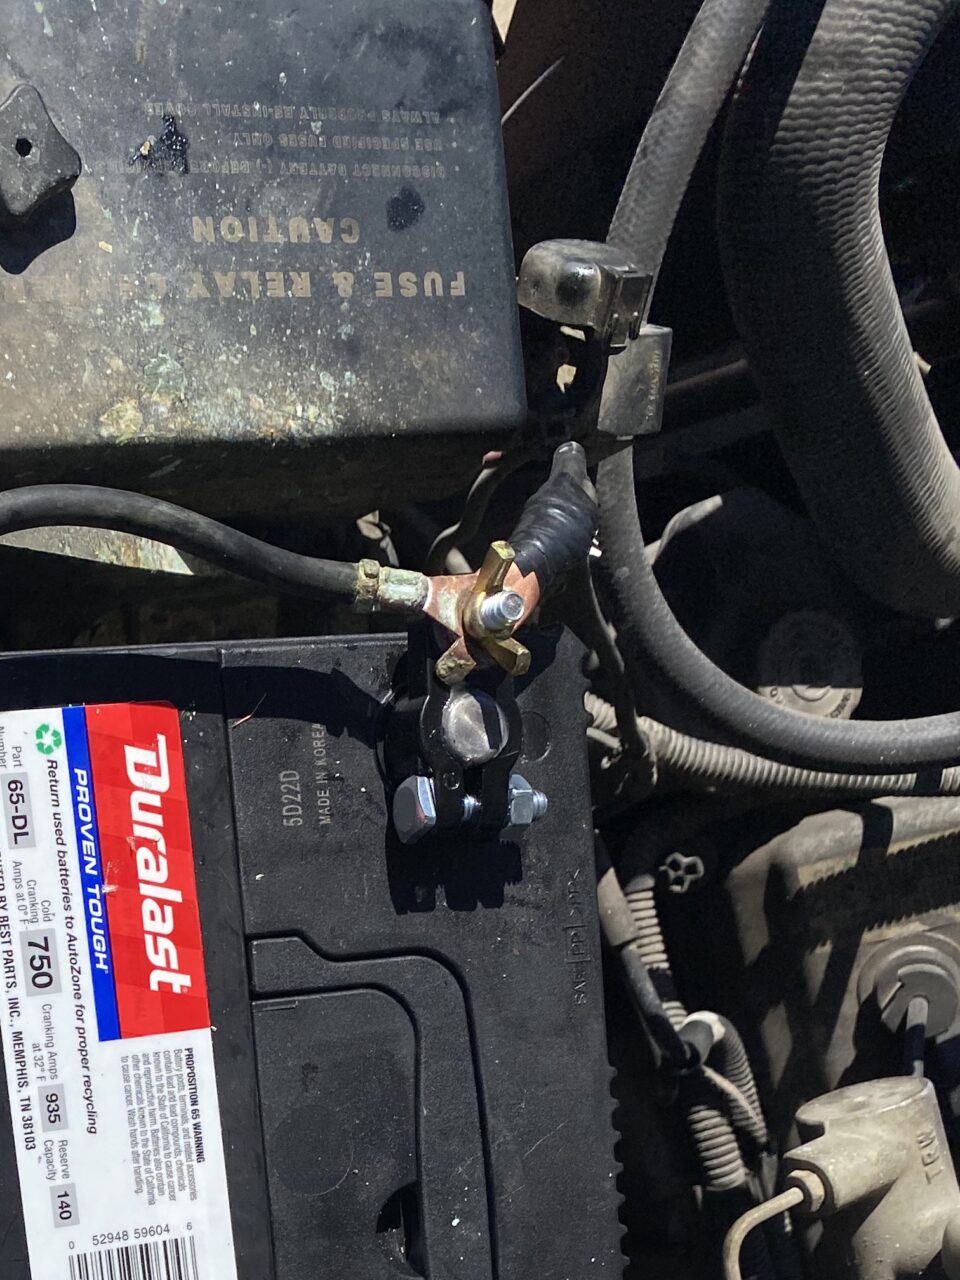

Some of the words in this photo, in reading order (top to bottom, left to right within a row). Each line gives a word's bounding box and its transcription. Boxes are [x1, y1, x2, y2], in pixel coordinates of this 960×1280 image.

[192, 215, 361, 243] CAUTION
[189, 270, 312, 299] RELAY
[333, 271, 355, 298] &
[374, 270, 466, 297] FUSE
[11, 745, 23, 767] Part
[310, 723, 327, 766] KOREA
[46, 759, 62, 807] Return
[315, 770, 328, 784] IN
[6, 779, 29, 844] 65-DL
[279, 769, 303, 827] 5D22D
[316, 790, 332, 825] MADE
[52, 812, 66, 846] used
[10, 860, 24, 889] Amps
[56, 849, 74, 911] batteries
[73, 767, 97, 876] PROVEN
[86, 884, 108, 970] TOUGH
[123, 733, 191, 997] Duralast
[16, 891, 25, 901] at
[25, 879, 40, 923] Cranking
[41, 899, 52, 922] Cold
[64, 915, 75, 929] to
[0, 949, 17, 993] PARTS,
[26, 936, 53, 989] 750
[66, 932, 84, 999] AutoZone
[6, 997, 21, 1027] INC.,
[39, 1003, 56, 1048] Cranking
[74, 1003, 86, 1023] for
[10, 1030, 29, 1092] MEMPHIS,
[32, 1042, 42, 1052] at
[74, 1026, 90, 1072] proper
[45, 1050, 60, 1080] Amps
[184, 1047, 198, 1106] PROPOSITION
[19, 1095, 31, 1112] TN
[44, 1092, 61, 1124] 935
[80, 1074, 99, 1134] recycling
[190, 1108, 200, 1120] 65
[21, 1114, 36, 1150] 38103
[192, 1122, 205, 1163] WARNING
[41, 1139, 57, 1181] Capacity
[57, 1139, 72, 1179] Reserve
[55, 1189, 72, 1221] 140
[68, 1241, 74, 1249] 0
[91, 1230, 128, 1245] 52948
[133, 1223, 169, 1239] 59604
[186, 1222, 192, 1230] 6
